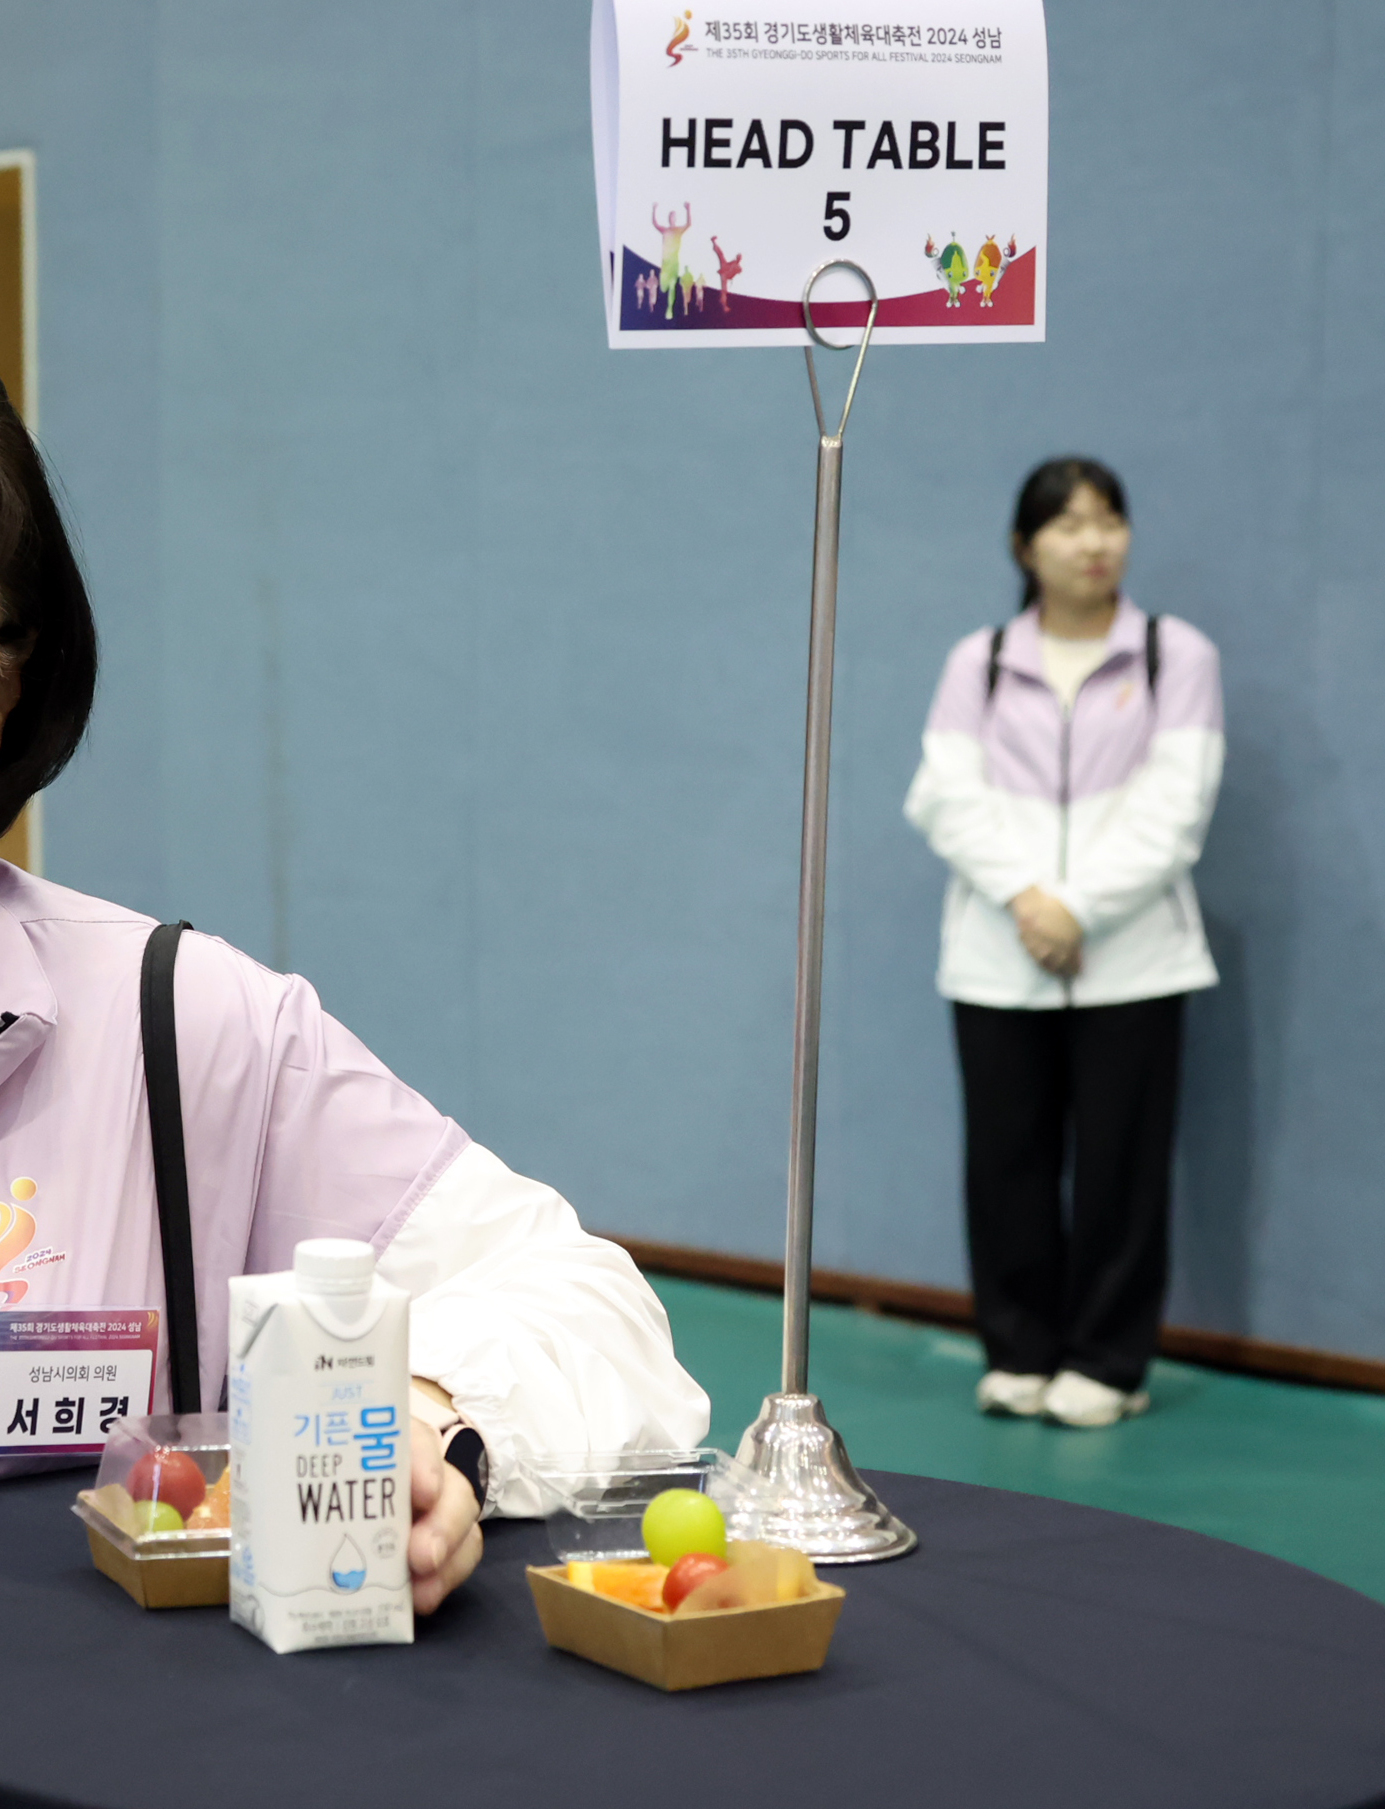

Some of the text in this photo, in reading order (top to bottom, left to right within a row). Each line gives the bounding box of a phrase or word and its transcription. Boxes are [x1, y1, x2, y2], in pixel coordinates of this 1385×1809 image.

[705, 20, 1002, 49] 제35회 경기도생활체육대축전 2024 성남
[706, 48, 1002, 64] THE 35TH GYEONGGI-DO SPORTS FOR ALL FESTIVAL 2024 SEONGNAM
[660, 117, 1006, 170] HEAD TABLE
[823, 191, 852, 242] 5
[14, 1253, 66, 1273] SEONGNAM
[26, 1249, 52, 1262] 2024
[107, 1322, 126, 1332] 2024
[29, 1365, 117, 1383] 성남시의회 의원
[296, 1454, 343, 1478] DEEP
[298, 1477, 396, 1524] WATER
